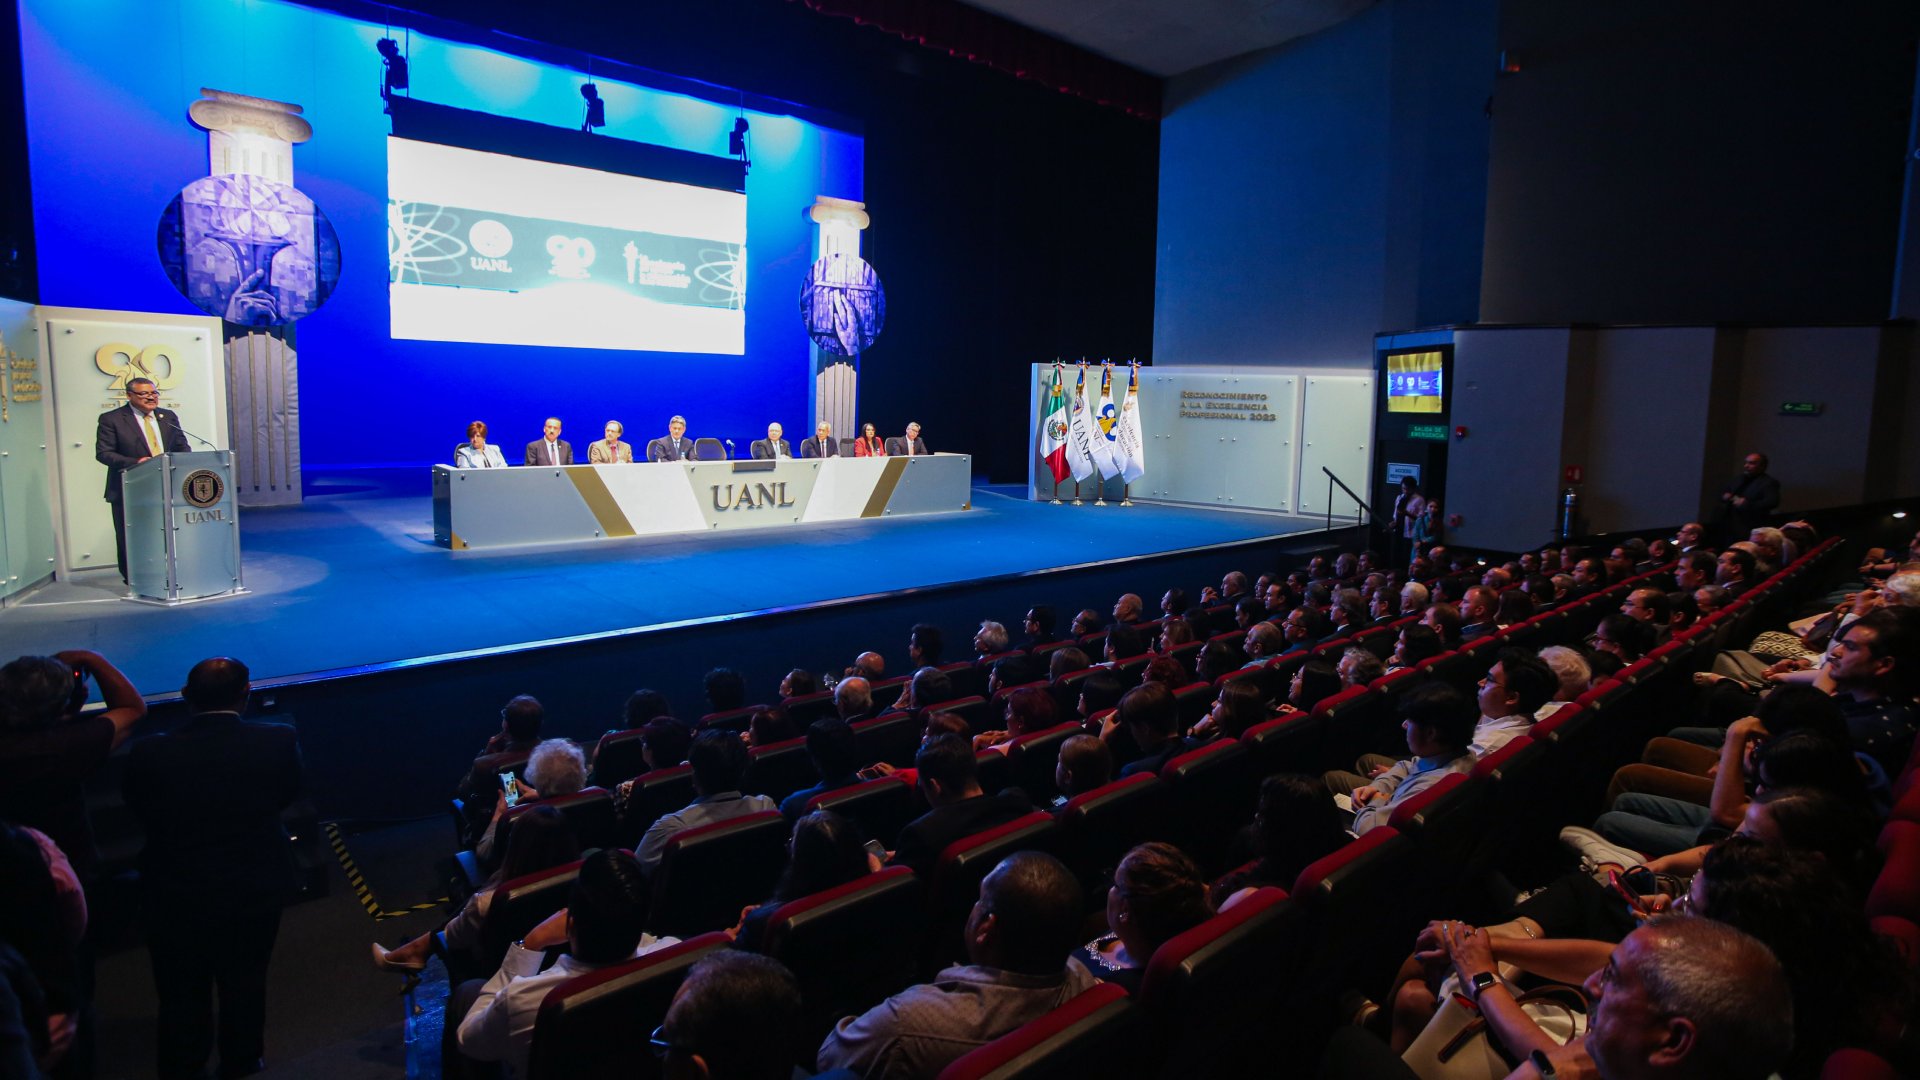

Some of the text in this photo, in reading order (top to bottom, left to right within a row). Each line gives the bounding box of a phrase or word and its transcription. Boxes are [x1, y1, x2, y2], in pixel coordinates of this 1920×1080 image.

[470, 257, 512, 273] UANL
[1182, 391, 1268, 401] RECONOCIMIENTO
[1205, 402, 1268, 411] EXCELENCIA
[1180, 411, 1276, 421] PROFESIONAL 2023
[1072, 419, 1091, 461] UANL
[712, 482, 796, 512] UANL
[185, 509, 226, 524] UANL
